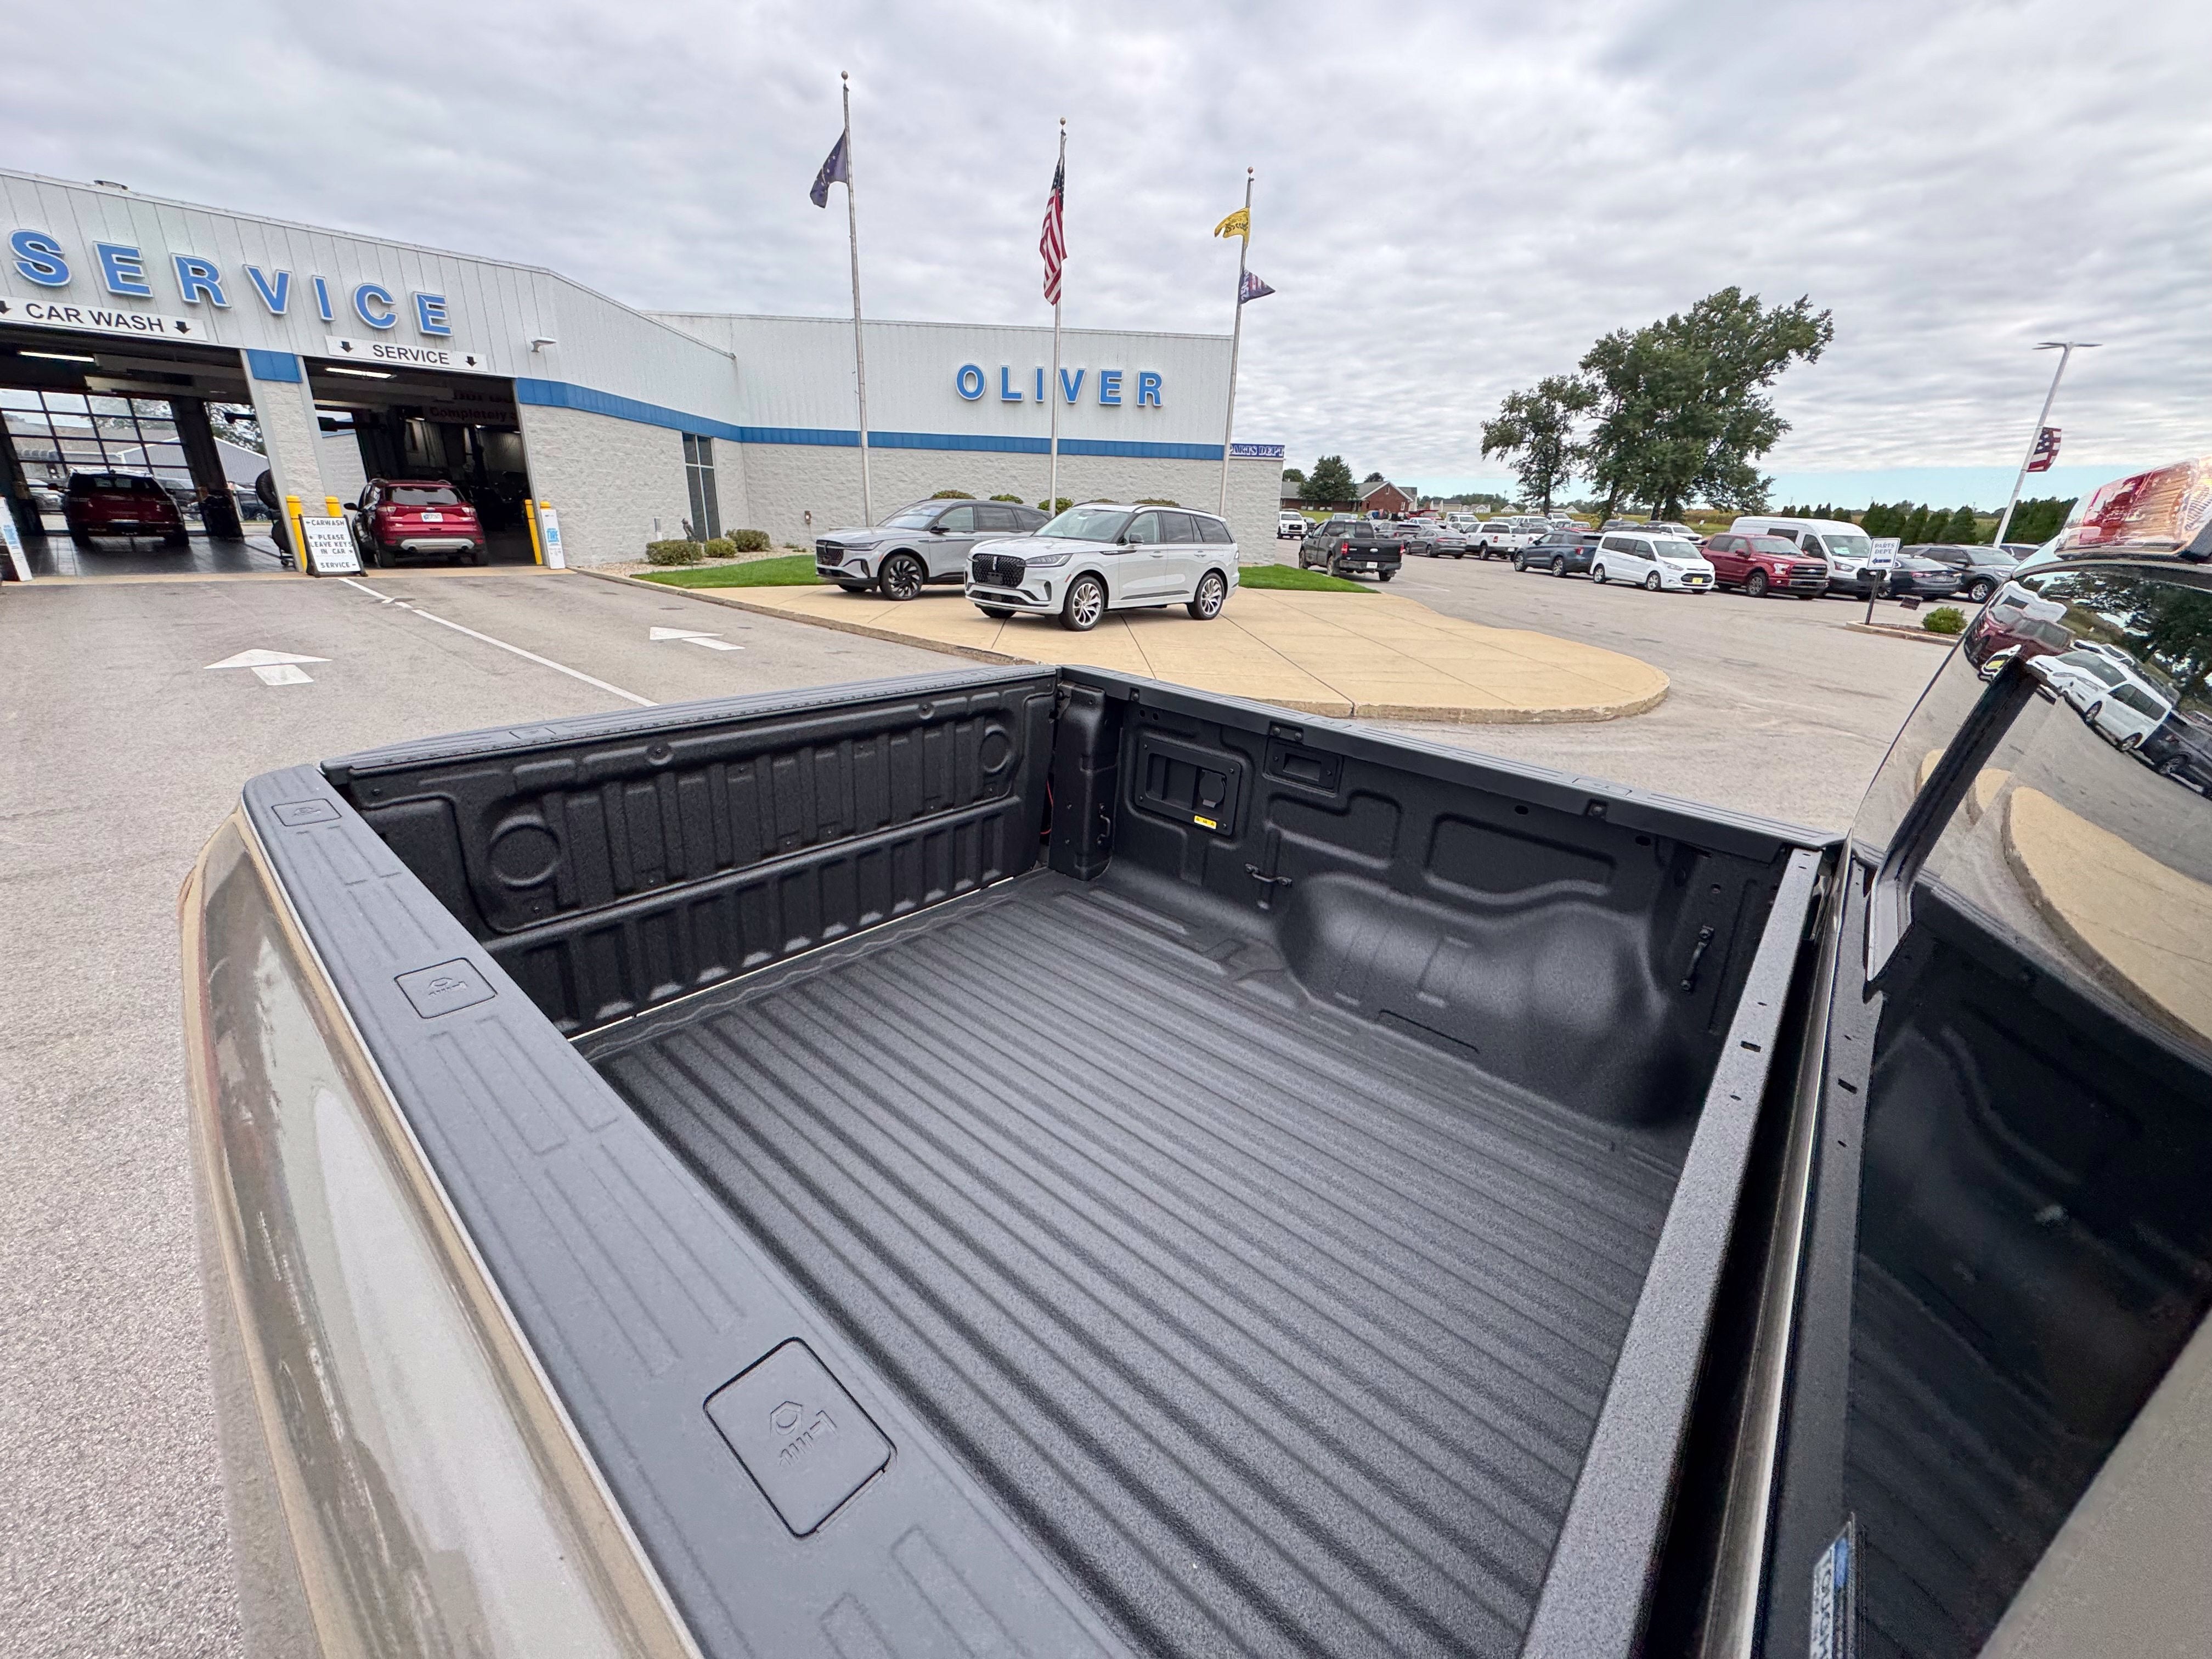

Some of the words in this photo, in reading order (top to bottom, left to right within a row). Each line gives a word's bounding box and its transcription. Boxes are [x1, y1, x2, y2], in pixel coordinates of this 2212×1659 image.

[9, 229, 453, 336] SERVICE
[26, 303, 84, 324] CAR
[88, 310, 165, 332] WASH
[373, 345, 450, 365] SERVICE
[956, 363, 1164, 407] OLIVER
[1259, 446, 1284, 456] DEPT
